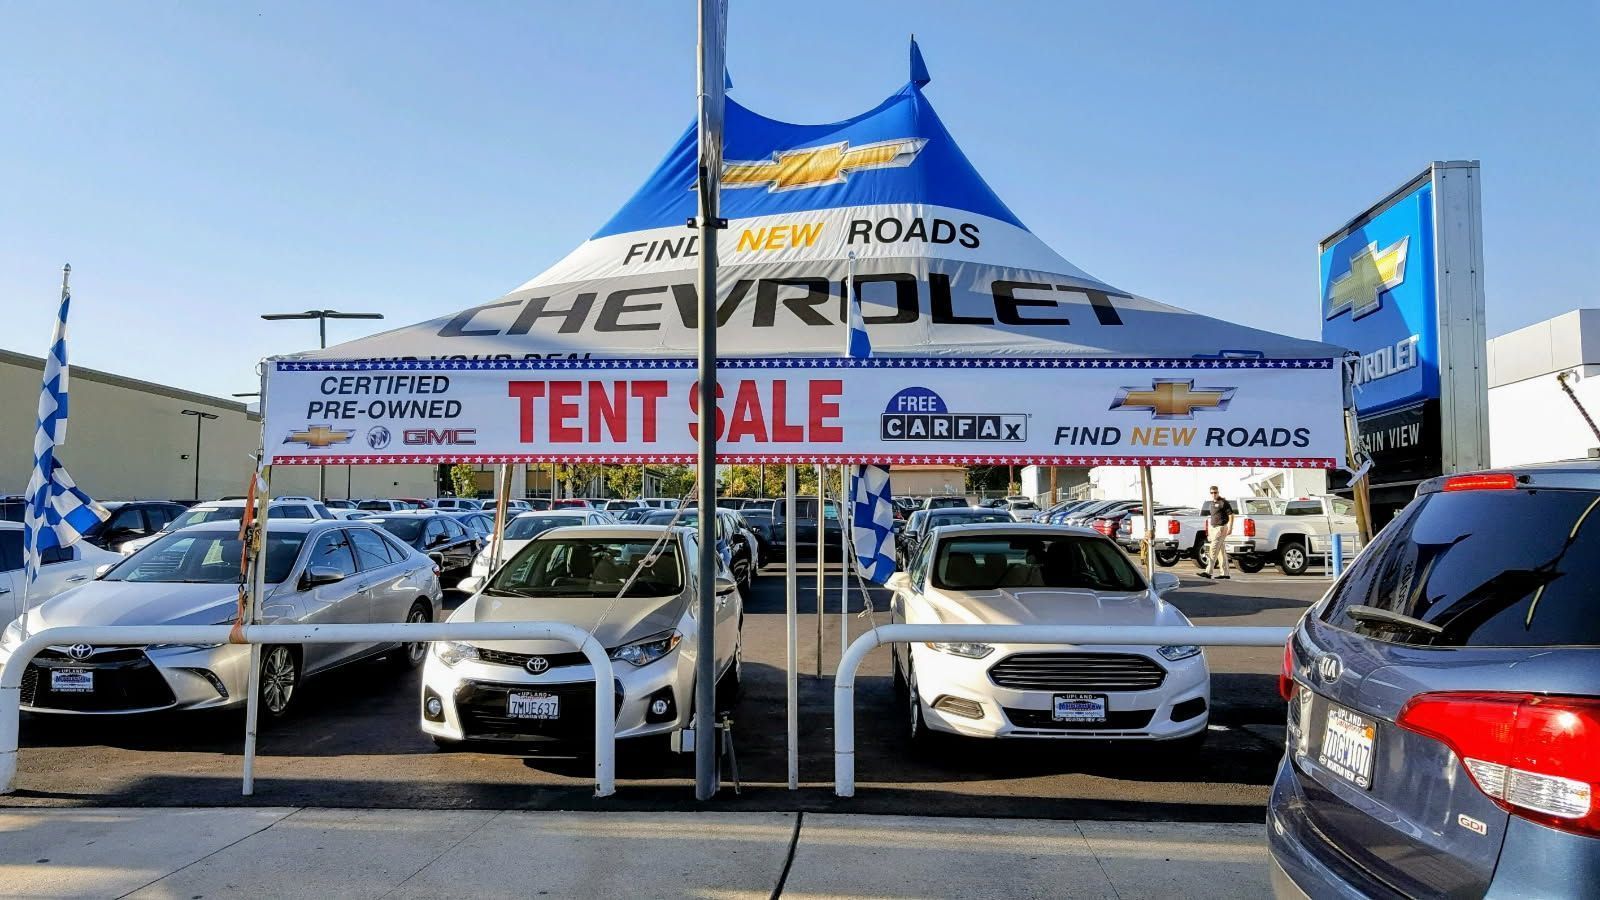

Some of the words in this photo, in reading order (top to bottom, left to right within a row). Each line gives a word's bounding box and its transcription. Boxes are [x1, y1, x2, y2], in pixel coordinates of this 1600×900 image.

[736, 222, 824, 253] NEW
[848, 217, 981, 249] ROADS
[437, 273, 1132, 338] CHEVROLET
[1353, 334, 1420, 385] VROLET
[320, 375, 450, 395] CERTIFIED
[307, 400, 462, 420] PRE-OWNED
[508, 380, 668, 443] TENT
[688, 380, 844, 444] SALE
[897, 396, 937, 412] FREE
[402, 428, 477, 446] GMC
[886, 418, 1022, 440] CARFAX
[1054, 427, 1121, 447] FIND
[1130, 427, 1198, 447] NEW
[1205, 427, 1311, 448] ROADS
[1389, 423, 1420, 449] VIEW
[511, 701, 557, 715] 7MUE637
[1337, 708, 1363, 726] UPLAND
[1460, 817, 1483, 832] GDI
